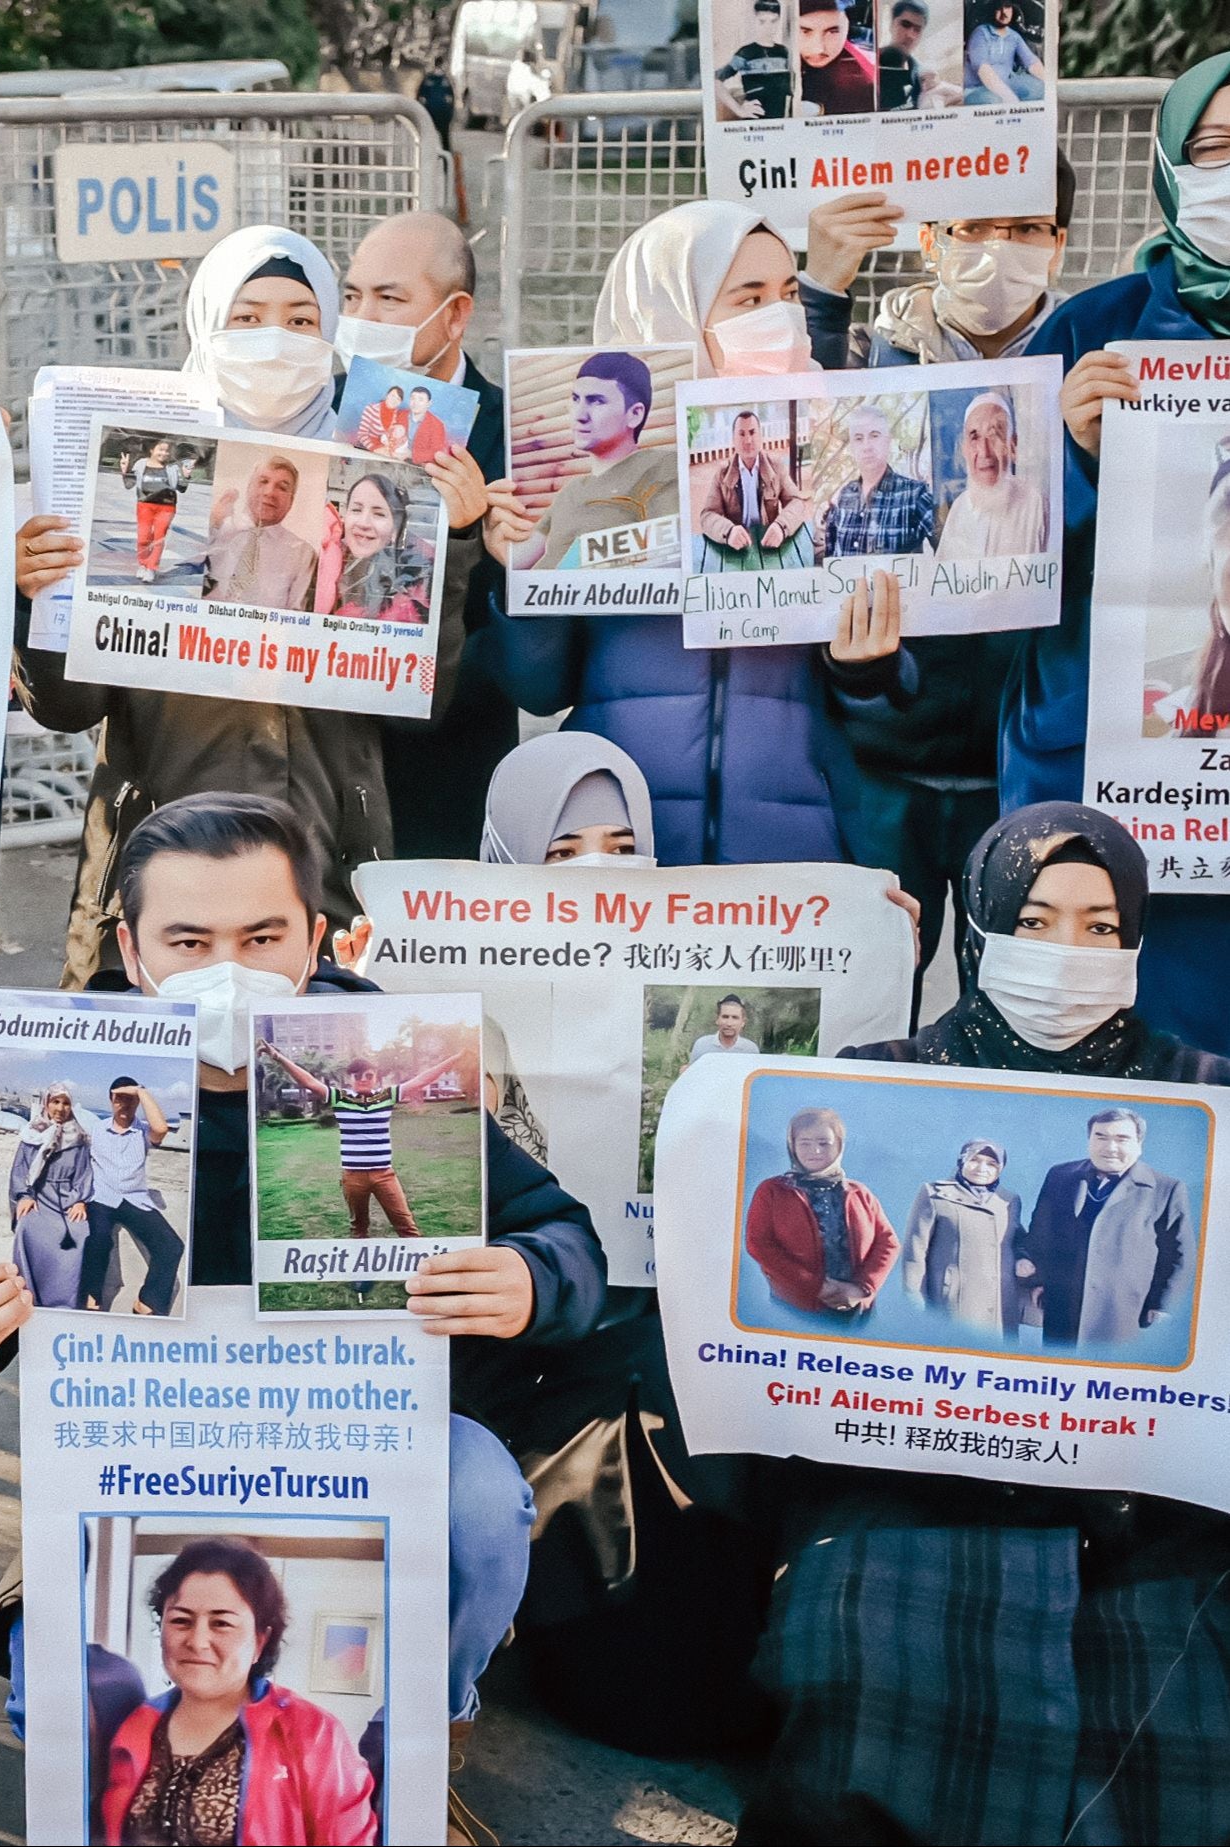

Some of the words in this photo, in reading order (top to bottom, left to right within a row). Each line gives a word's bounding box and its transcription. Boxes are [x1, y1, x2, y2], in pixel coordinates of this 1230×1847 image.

[739, 157, 797, 198] Çin!
[810, 156, 893, 188] Ailem
[76, 161, 221, 236] POLİS
[525, 584, 581, 606] Zahir
[583, 582, 680, 606] Abdullah
[756, 576, 823, 609] Mamut
[930, 560, 999, 597] Abidin
[1005, 557, 1059, 591] Ayup
[185, 603, 198, 614] old
[298, 616, 311, 626] old
[95, 614, 170, 658] China!
[178, 624, 251, 668] Where
[258, 633, 278, 671] is
[286, 646, 320, 684] my
[719, 620, 733, 640] in
[741, 618, 780, 642] Camp
[1115, 816, 1176, 842] ina
[401, 889, 533, 924] Where
[546, 892, 579, 923] Is
[595, 892, 653, 933] My
[668, 892, 831, 935] Family?
[373, 937, 469, 965] Ailem
[479, 940, 613, 968] nerede?
[92, 1016, 192, 1048] Abdullah
[283, 1246, 349, 1280] Raşit
[352, 1244, 449, 1273] Ablim
[52, 1333, 103, 1371] Çin!
[111, 1335, 218, 1365] Annemi
[225, 1335, 327, 1366] serbest
[334, 1335, 417, 1367] bırak.
[49, 1377, 136, 1408] China!
[145, 1378, 251, 1409] Release
[258, 1386, 299, 1418] my
[307, 1380, 419, 1411] mother.
[696, 1342, 788, 1369] China!
[796, 1350, 915, 1383] Release
[924, 1363, 966, 1391] My
[976, 1369, 1076, 1402] Family
[1086, 1378, 1230, 1414] Members
[766, 1381, 822, 1407] Çin!
[830, 1388, 924, 1417] Ailemi
[934, 1399, 1050, 1431] Serbest
[98, 1465, 370, 1505] #FreeSuriyeTursun
